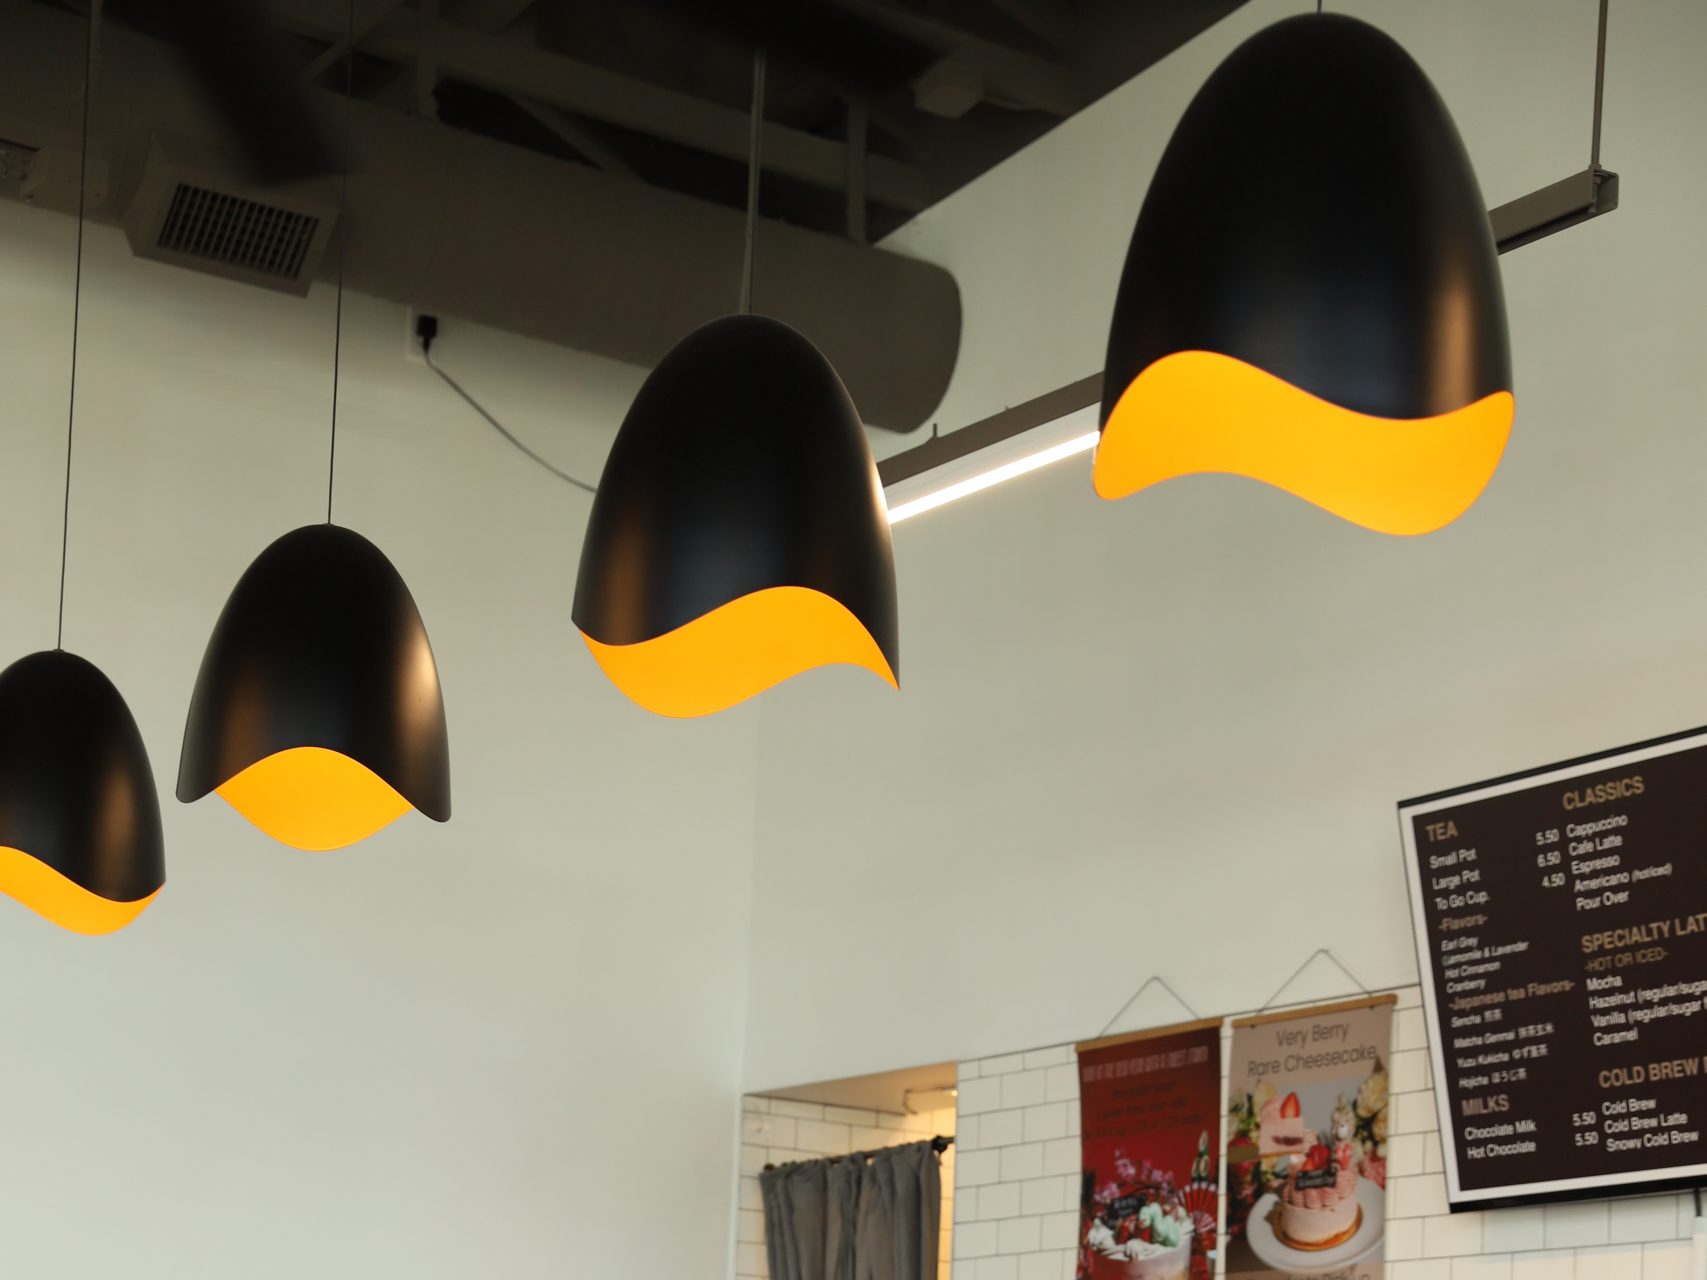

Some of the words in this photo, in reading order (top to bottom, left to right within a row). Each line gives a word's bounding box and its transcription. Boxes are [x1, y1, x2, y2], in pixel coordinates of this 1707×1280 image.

[1563, 776, 1645, 810] CLASSICS
[1425, 820, 1458, 842] TEA
[1566, 814, 1628, 837] Cappuccino
[1535, 828, 1560, 846] 5.50
[1595, 835, 1623, 850] Latte
[1429, 851, 1458, 869] Small
[1458, 848, 1477, 862] Pot
[1571, 855, 1620, 874] Espresso
[1432, 874, 1461, 890] Large
[1462, 869, 1481, 883] Pot
[1542, 872, 1565, 888] 4.50
[1574, 872, 1630, 892] Americano
[1435, 897, 1449, 910] To
[1449, 894, 1465, 908] Go
[1576, 896, 1601, 911] Pour
[1602, 891, 1629, 906] Over
[1581, 920, 1671, 953] SPECIALTY
[1614, 952, 1633, 968] OR
[1586, 974, 1623, 991] Mocha
[1589, 990, 1636, 1010] Hazelnut
[1590, 1011, 1627, 1027] Vanilla
[1276, 1026, 1311, 1049] Very
[1311, 1022, 1350, 1045] Berry
[1593, 1027, 1639, 1046] Caramel
[1247, 1054, 1282, 1079] Rare
[1284, 1044, 1378, 1074] Cheesecake
[1599, 1065, 1645, 1089] COLD
[1648, 1058, 1699, 1082] BREW
[1461, 1094, 1510, 1117] MILKS
[1602, 1100, 1628, 1116] Cold
[1628, 1097, 1657, 1113] Brew
[1572, 1111, 1597, 1127] 5.50
[1604, 1118, 1630, 1134] Cold
[1631, 1115, 1659, 1130] Brew
[1659, 1111, 1688, 1127] Latte
[1464, 1123, 1515, 1142] Chocolate
[1515, 1119, 1537, 1135] Milk
[1575, 1131, 1599, 1147] 5.50
[1467, 1146, 1486, 1160] Hot
[1486, 1140, 1537, 1158] Chocolate
[1606, 1136, 1643, 1153] Snowy
[1643, 1132, 1670, 1148] Cold
[1670, 1129, 1699, 1144] Brew
